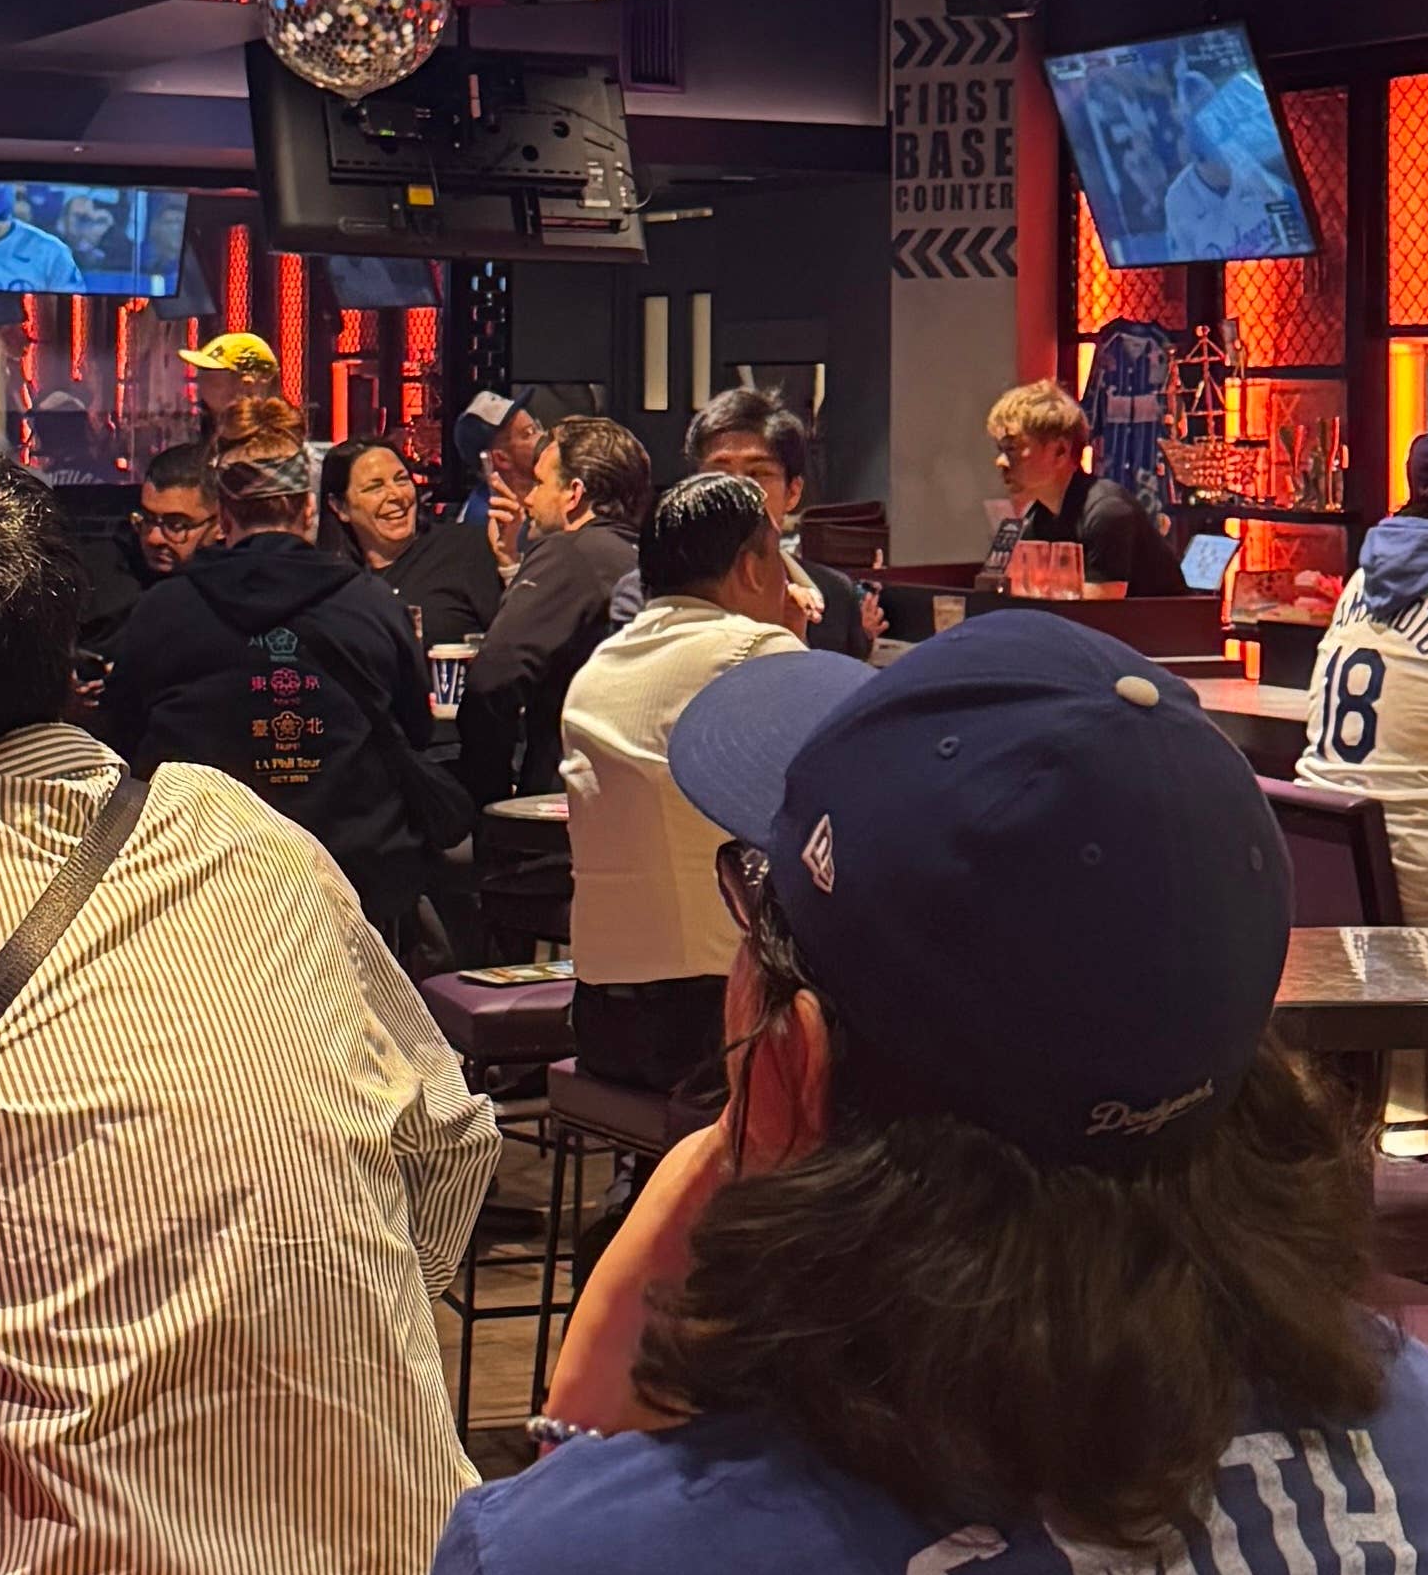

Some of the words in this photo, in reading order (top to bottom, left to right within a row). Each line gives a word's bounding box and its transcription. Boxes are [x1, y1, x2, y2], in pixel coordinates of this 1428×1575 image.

[895, 78, 1015, 125] FIRST
[895, 127, 1014, 180] BASE
[895, 182, 1014, 213] COUNTER
[305, 717, 324, 734] 北
[1317, 645, 1387, 765] 18
